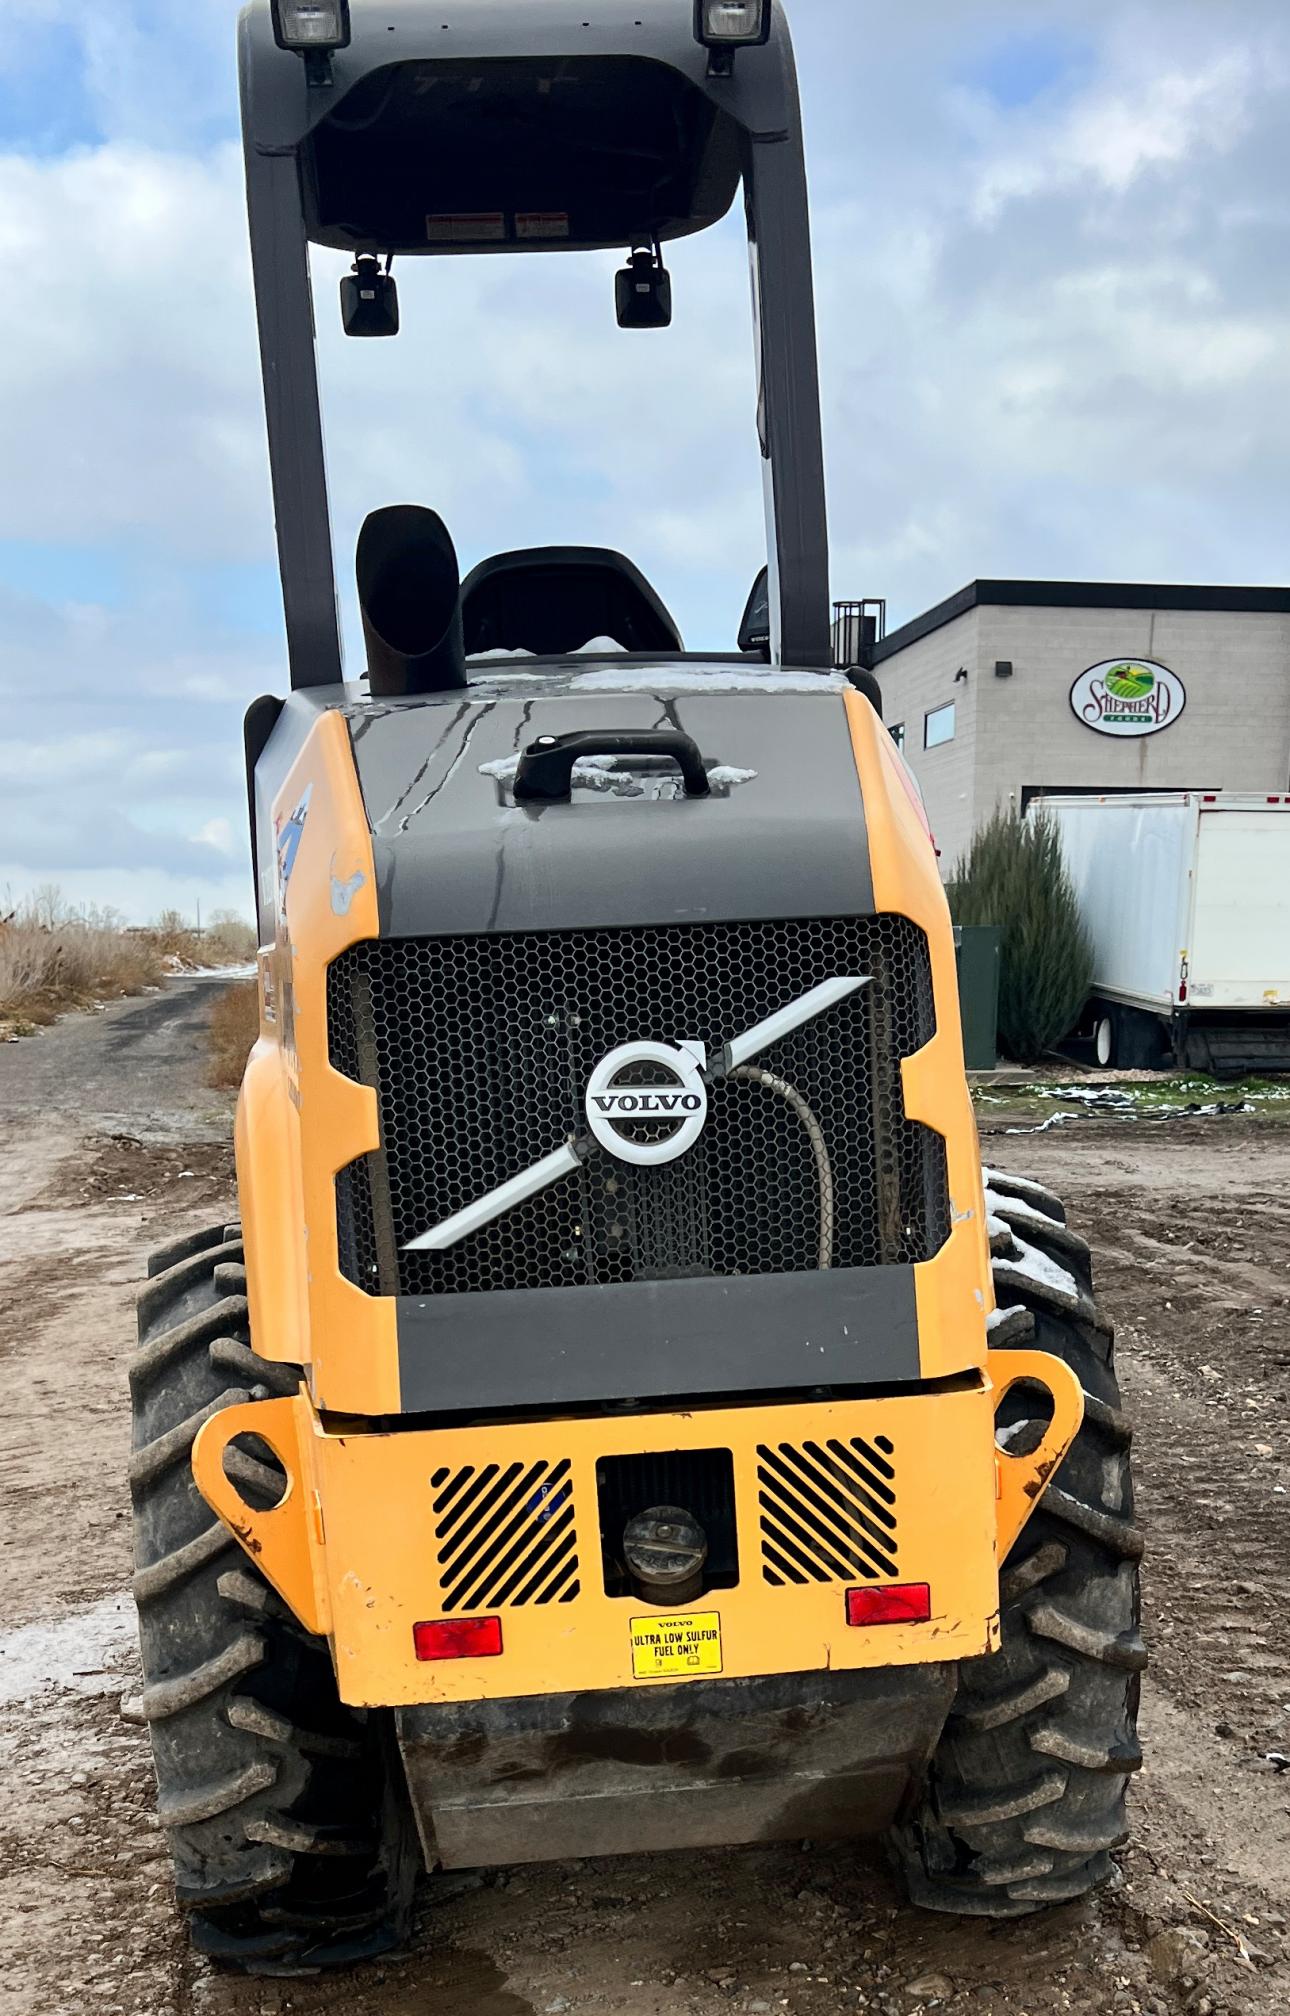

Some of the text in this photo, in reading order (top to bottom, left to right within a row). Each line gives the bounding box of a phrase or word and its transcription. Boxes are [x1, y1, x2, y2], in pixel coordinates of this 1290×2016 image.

[1083, 680, 1171, 724] SHEPHERD
[591, 1094, 702, 1112] VOLVO
[658, 1620, 693, 1628] VOLVO
[634, 1629, 718, 1646] ULTRA LOW SULFUR
[654, 1643, 699, 1657] FUEL ONLY
